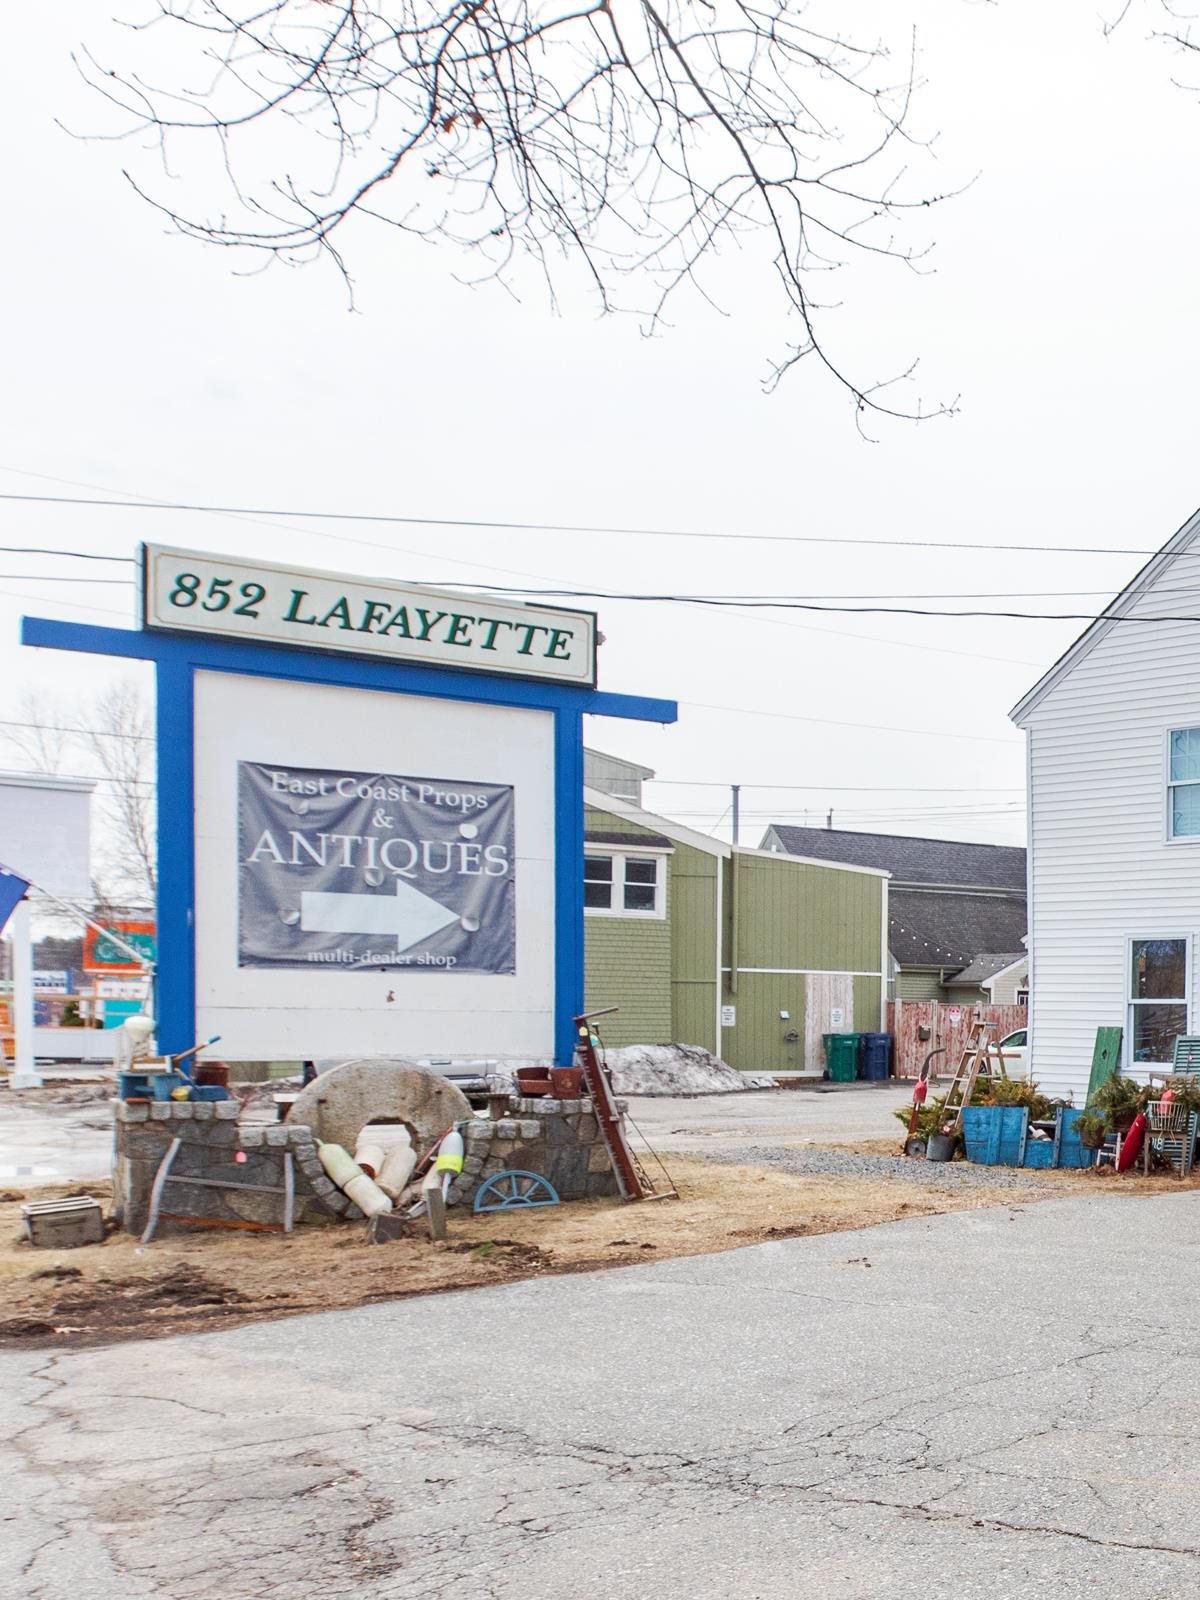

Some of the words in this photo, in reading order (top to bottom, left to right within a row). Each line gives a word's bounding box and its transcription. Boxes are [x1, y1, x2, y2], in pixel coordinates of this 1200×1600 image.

[168, 573, 266, 619] 852
[283, 590, 575, 661] LAFAYETTE
[272, 772, 329, 797] East
[336, 778, 411, 803] Coast
[418, 785, 489, 813] Props
[372, 808, 395, 830] &
[247, 829, 510, 878] ANTIQUES
[307, 949, 413, 965] multi-dealer
[417, 951, 457, 969] shop
